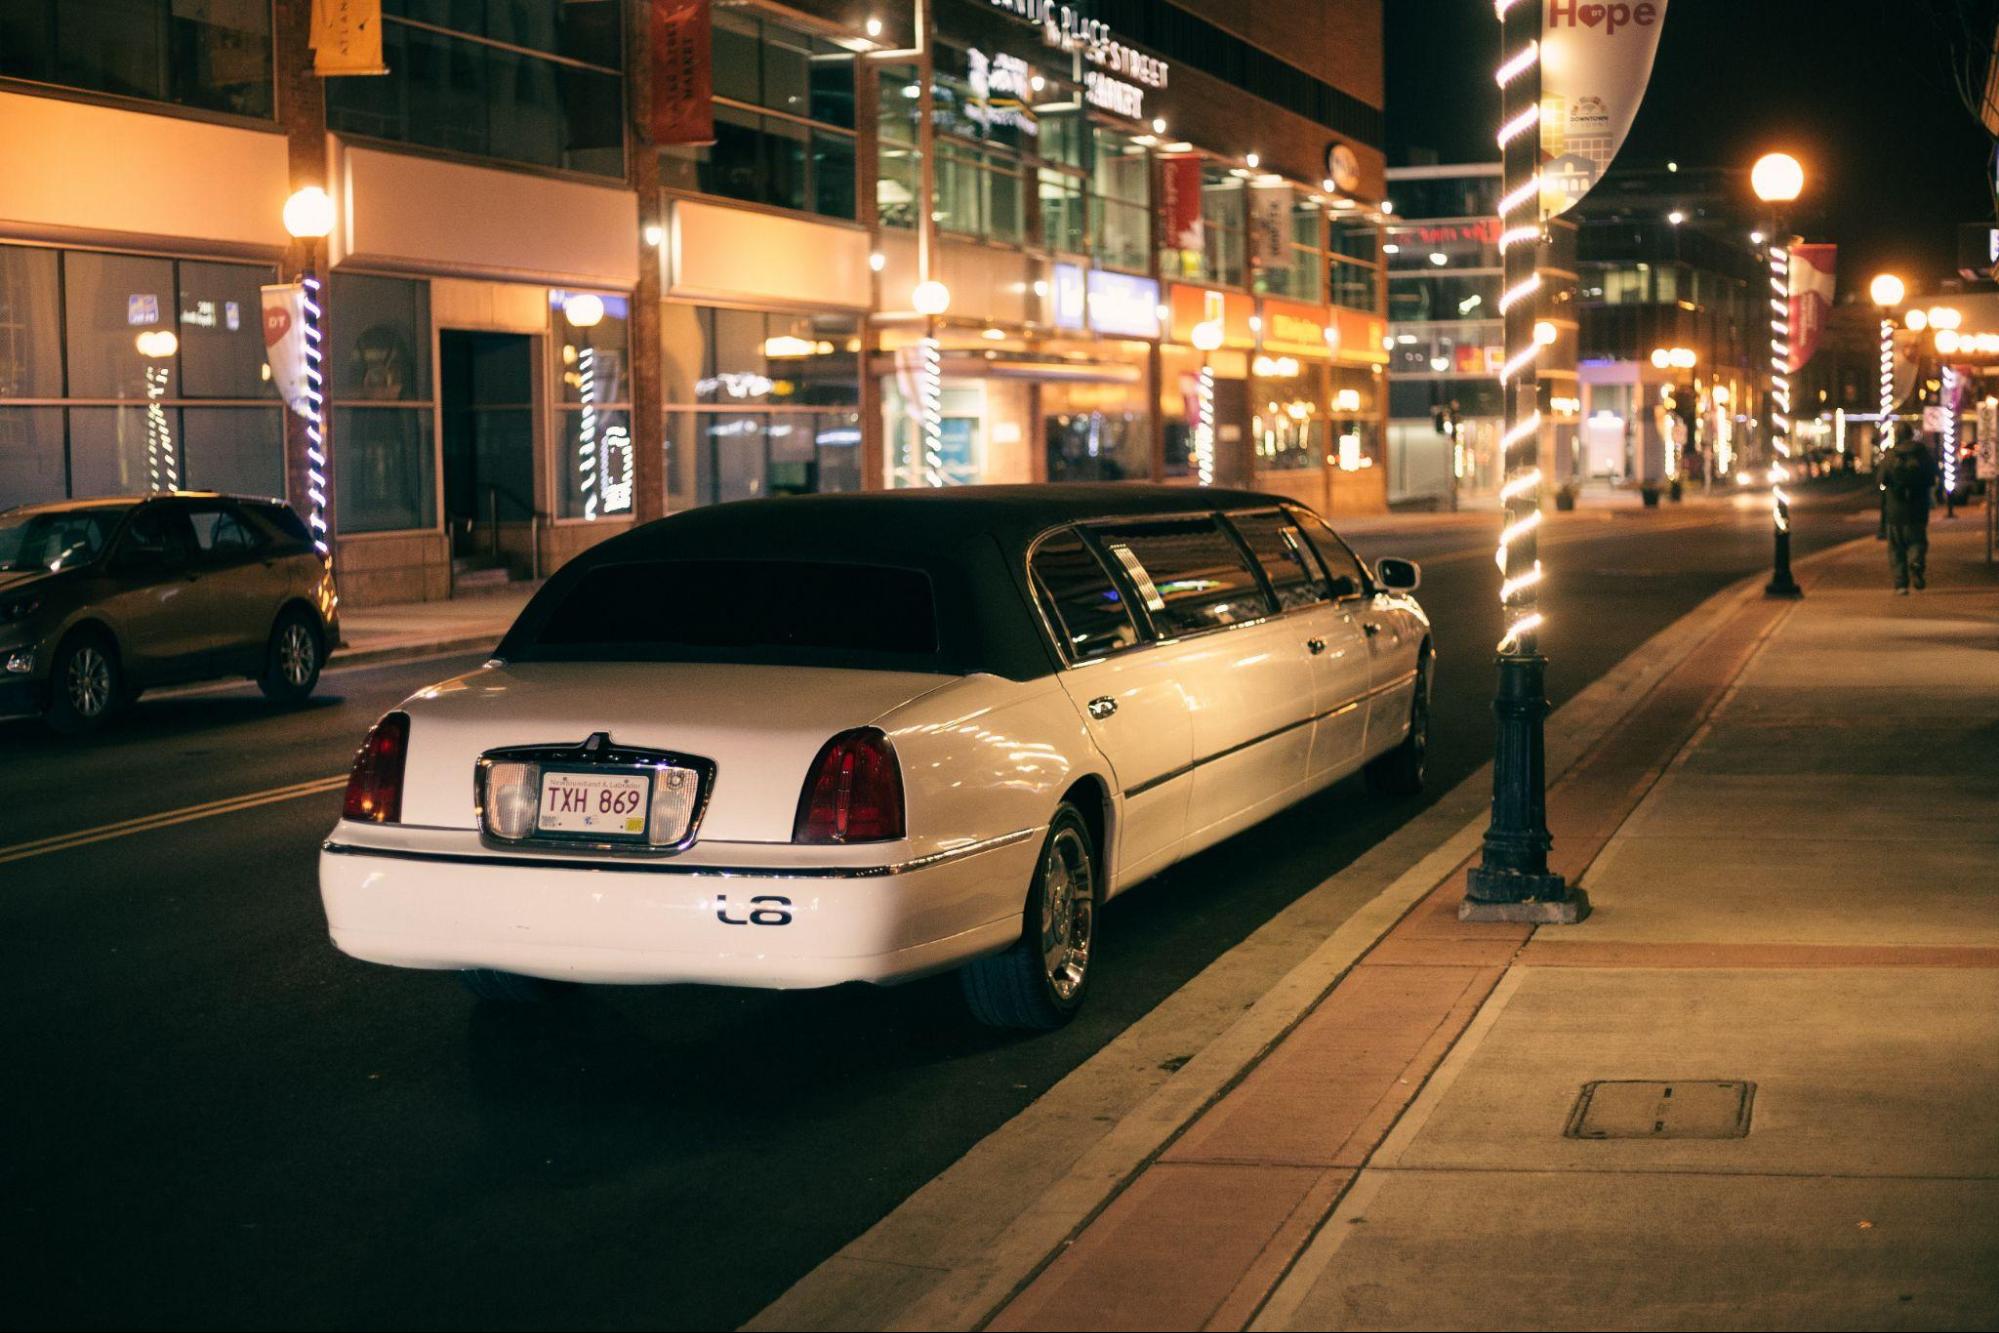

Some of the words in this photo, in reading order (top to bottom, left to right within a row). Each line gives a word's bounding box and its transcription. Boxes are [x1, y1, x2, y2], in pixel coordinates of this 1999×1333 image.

[1109, 41, 1169, 89] STREET
[268, 315, 286, 329] DT
[548, 787, 588, 813] TXH
[599, 789, 640, 814] 869
